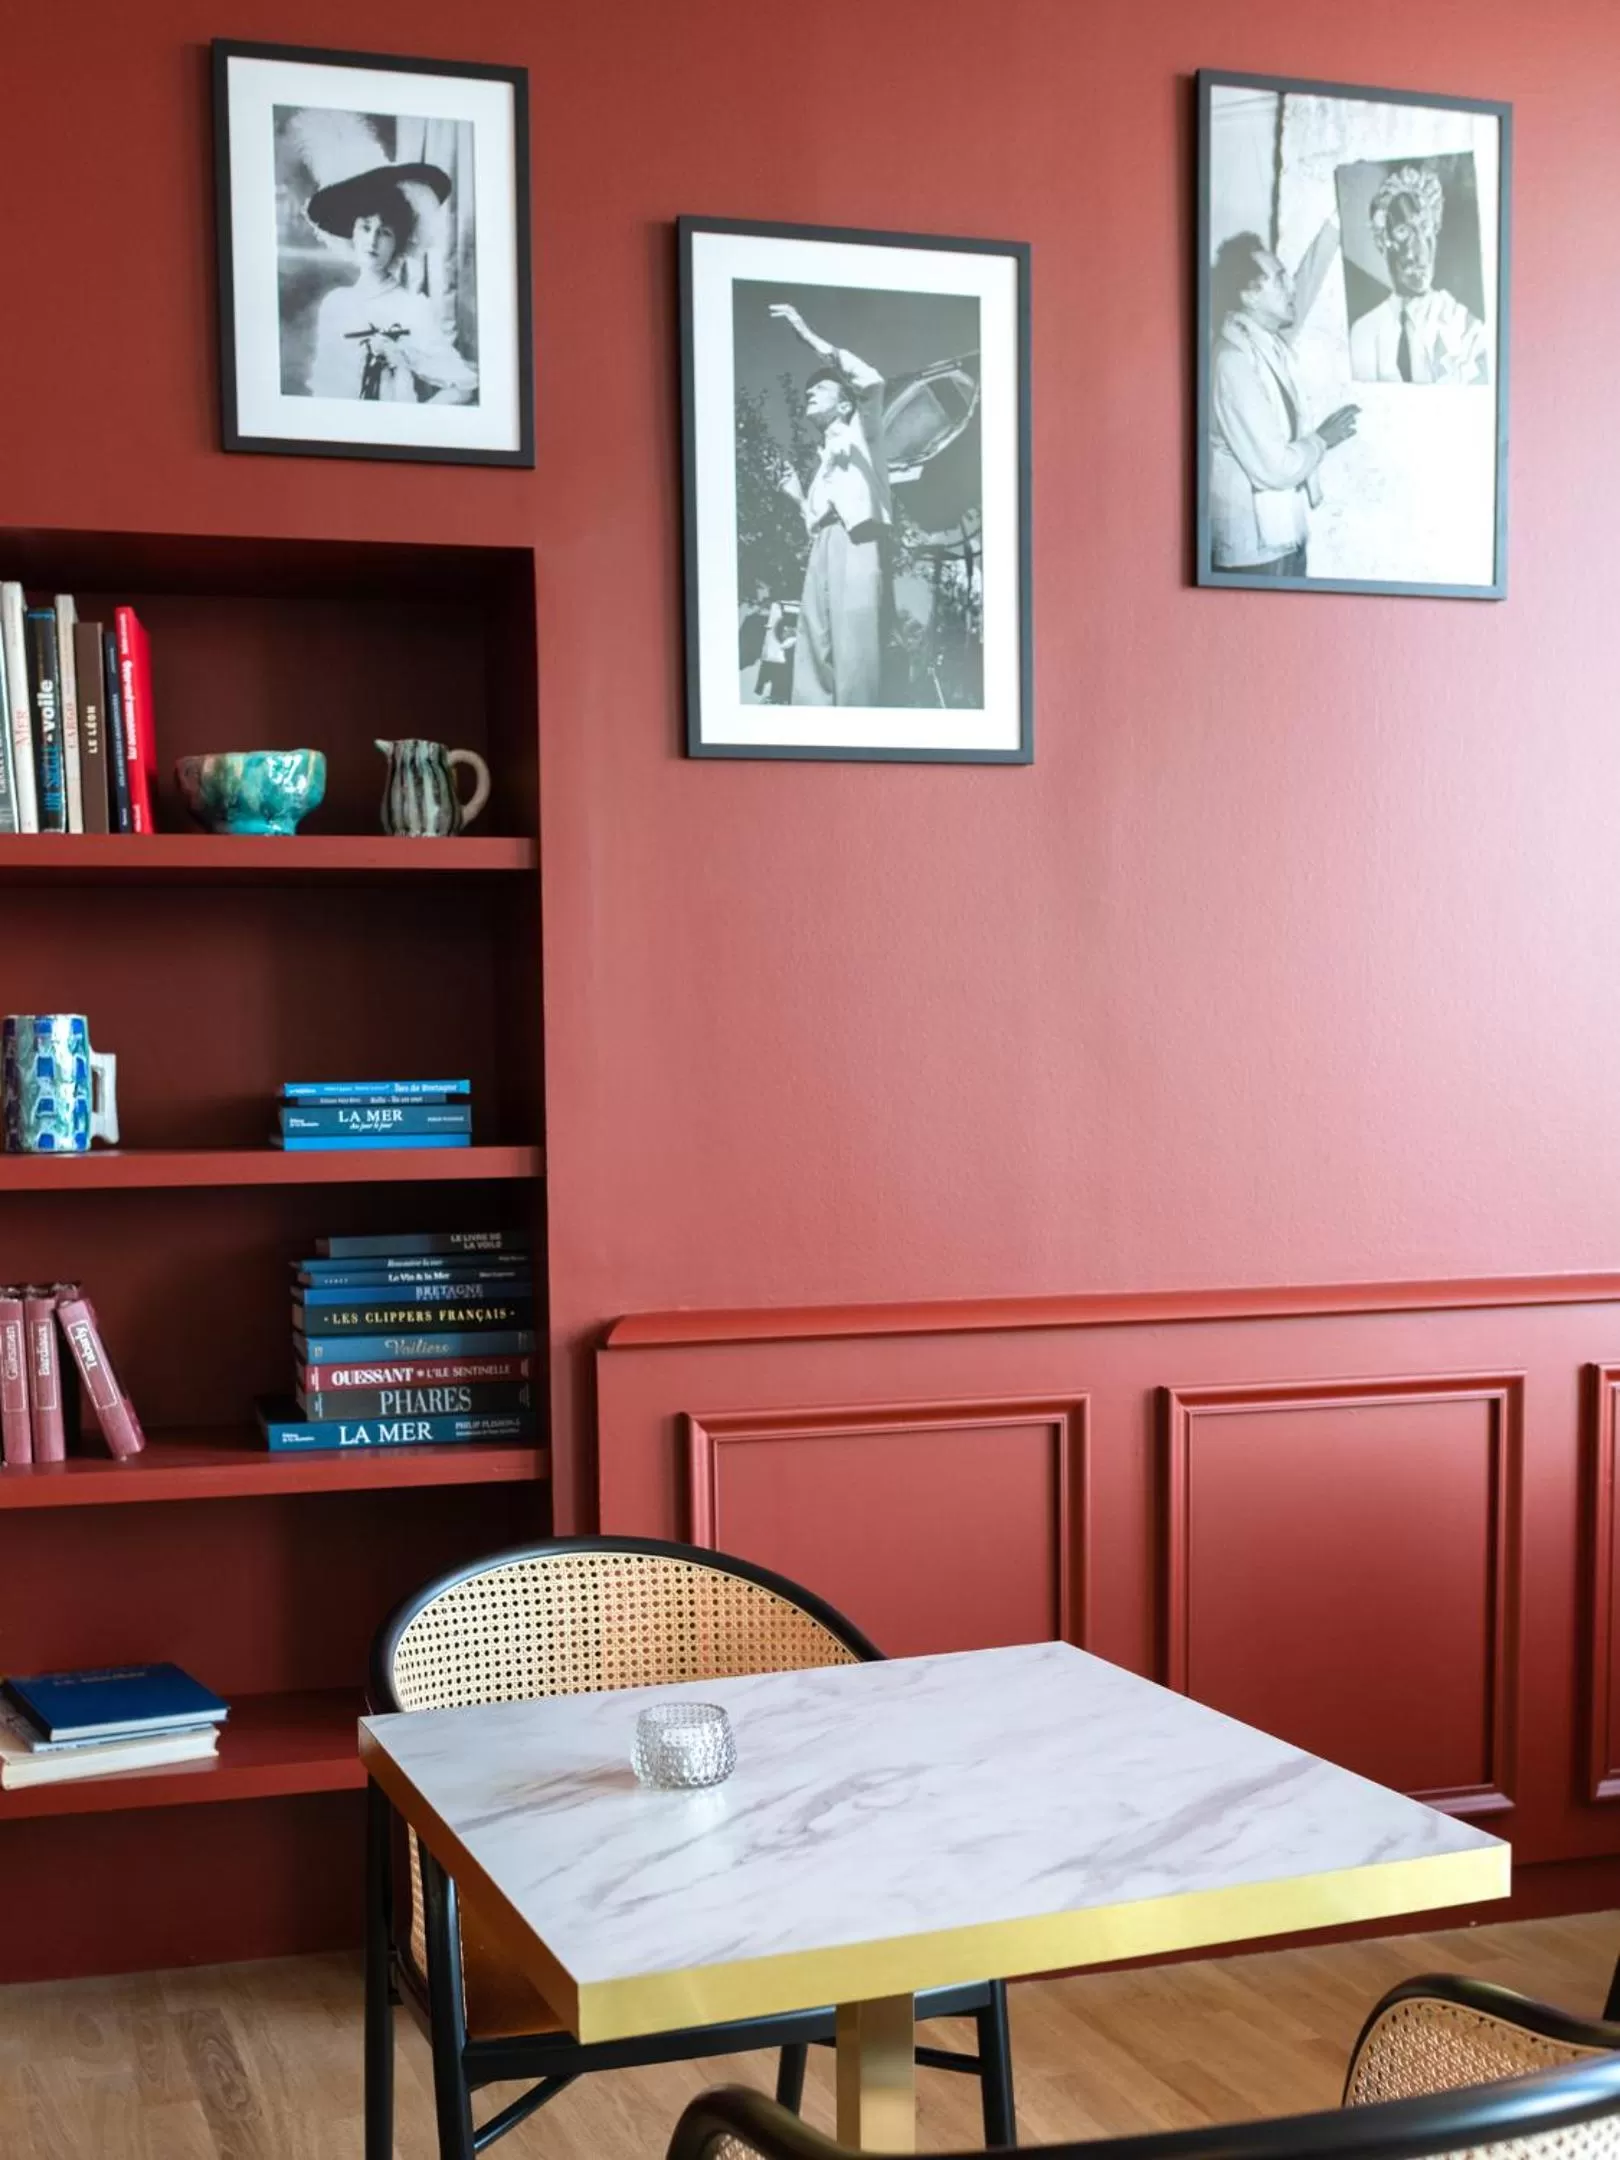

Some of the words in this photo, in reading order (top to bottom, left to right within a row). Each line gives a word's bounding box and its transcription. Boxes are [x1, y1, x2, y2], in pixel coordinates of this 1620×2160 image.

[37, 679, 55, 731] voile
[84, 705, 97, 737] LÉON
[88, 742, 98, 754] LE
[338, 1110, 361, 1123] LA
[366, 1108, 403, 1123] MER
[450, 1233, 461, 1243] LE
[463, 1232, 488, 1242] LIVRE
[463, 1241, 476, 1250] LA
[477, 1240, 502, 1250] VOILE
[424, 1272, 433, 1280] la
[433, 1271, 451, 1280] Mer
[415, 1284, 483, 1300] BRETAGNE
[332, 1312, 359, 1324] LES
[365, 1309, 433, 1323] CLIPPERS
[439, 1307, 507, 1323] FRANÇAIS
[75, 1327, 98, 1371] Tabarly
[384, 1337, 451, 1356] Voiliers
[331, 1367, 414, 1386] OUESSANT
[452, 1364, 511, 1378] SENTINELLE
[380, 1386, 472, 1415] PHARES
[339, 1424, 371, 1445] LA
[378, 1421, 434, 1443] MER
